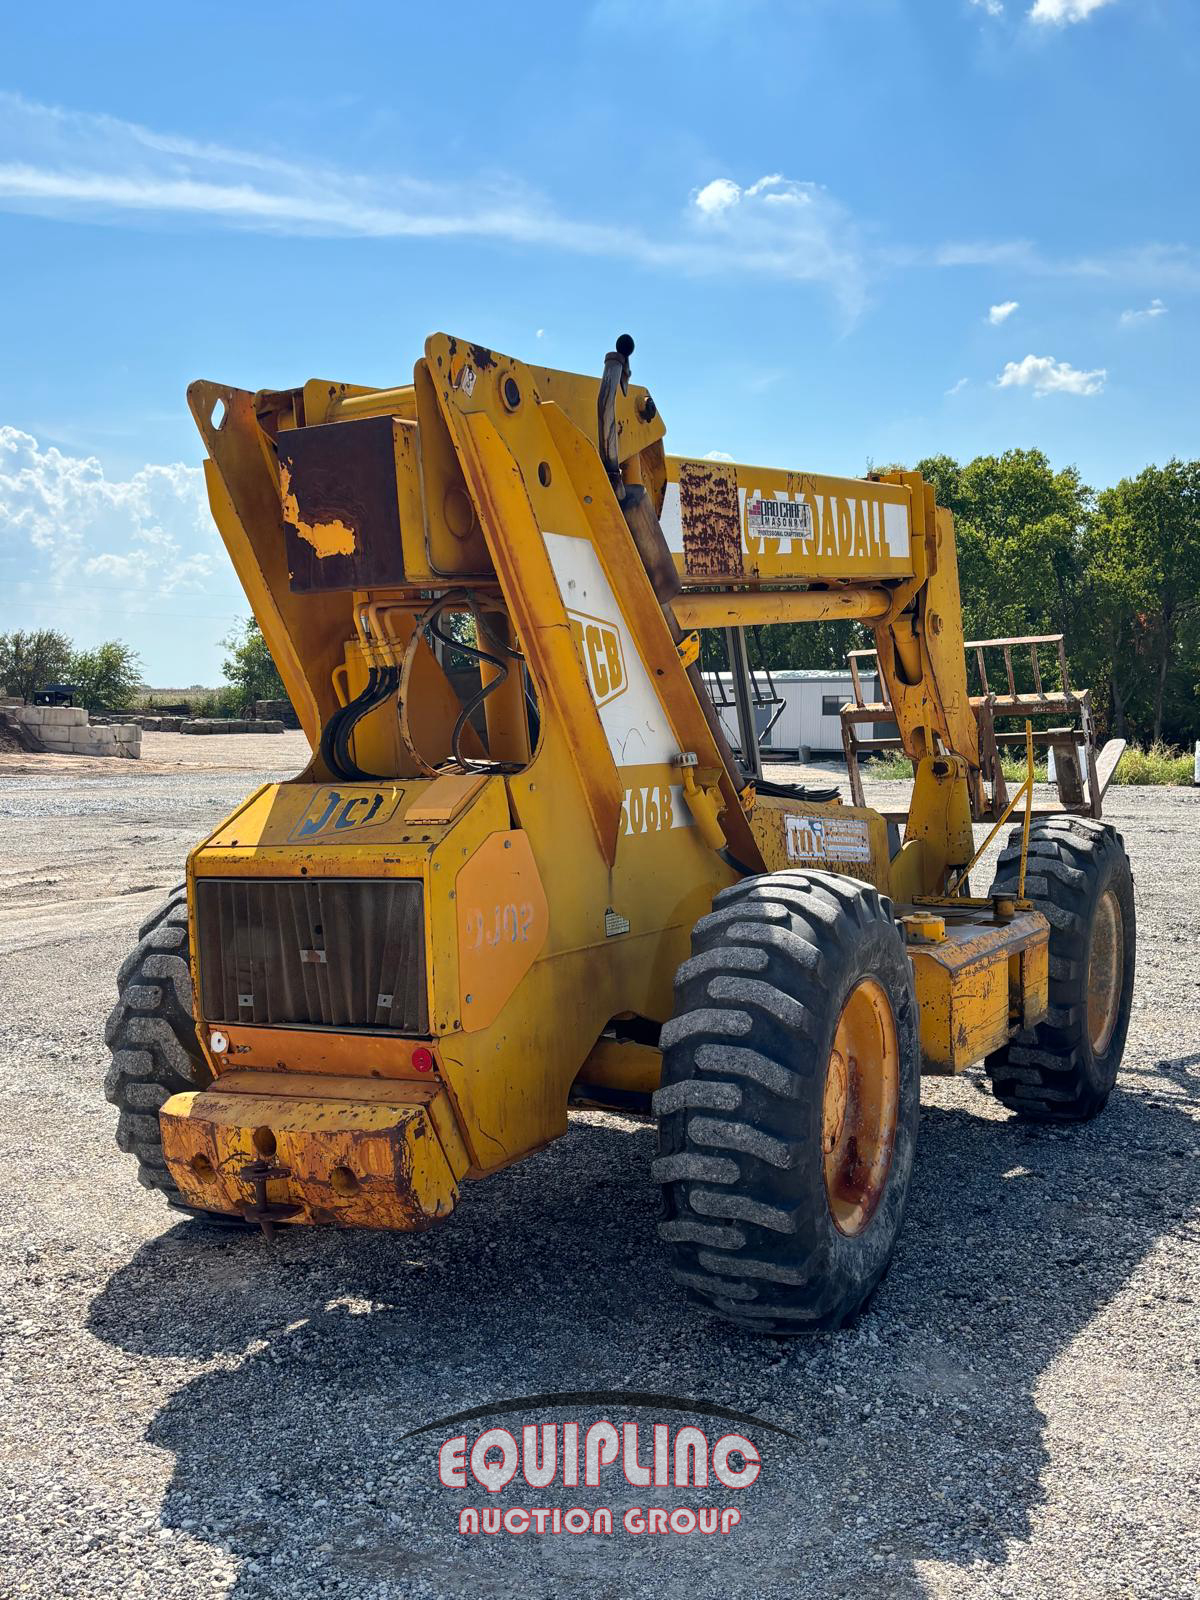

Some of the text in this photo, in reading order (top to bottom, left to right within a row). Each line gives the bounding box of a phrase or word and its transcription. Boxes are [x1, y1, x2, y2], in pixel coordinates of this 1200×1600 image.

[761, 501, 809, 527] PRO CRAFT
[764, 517, 803, 528] MASONRY
